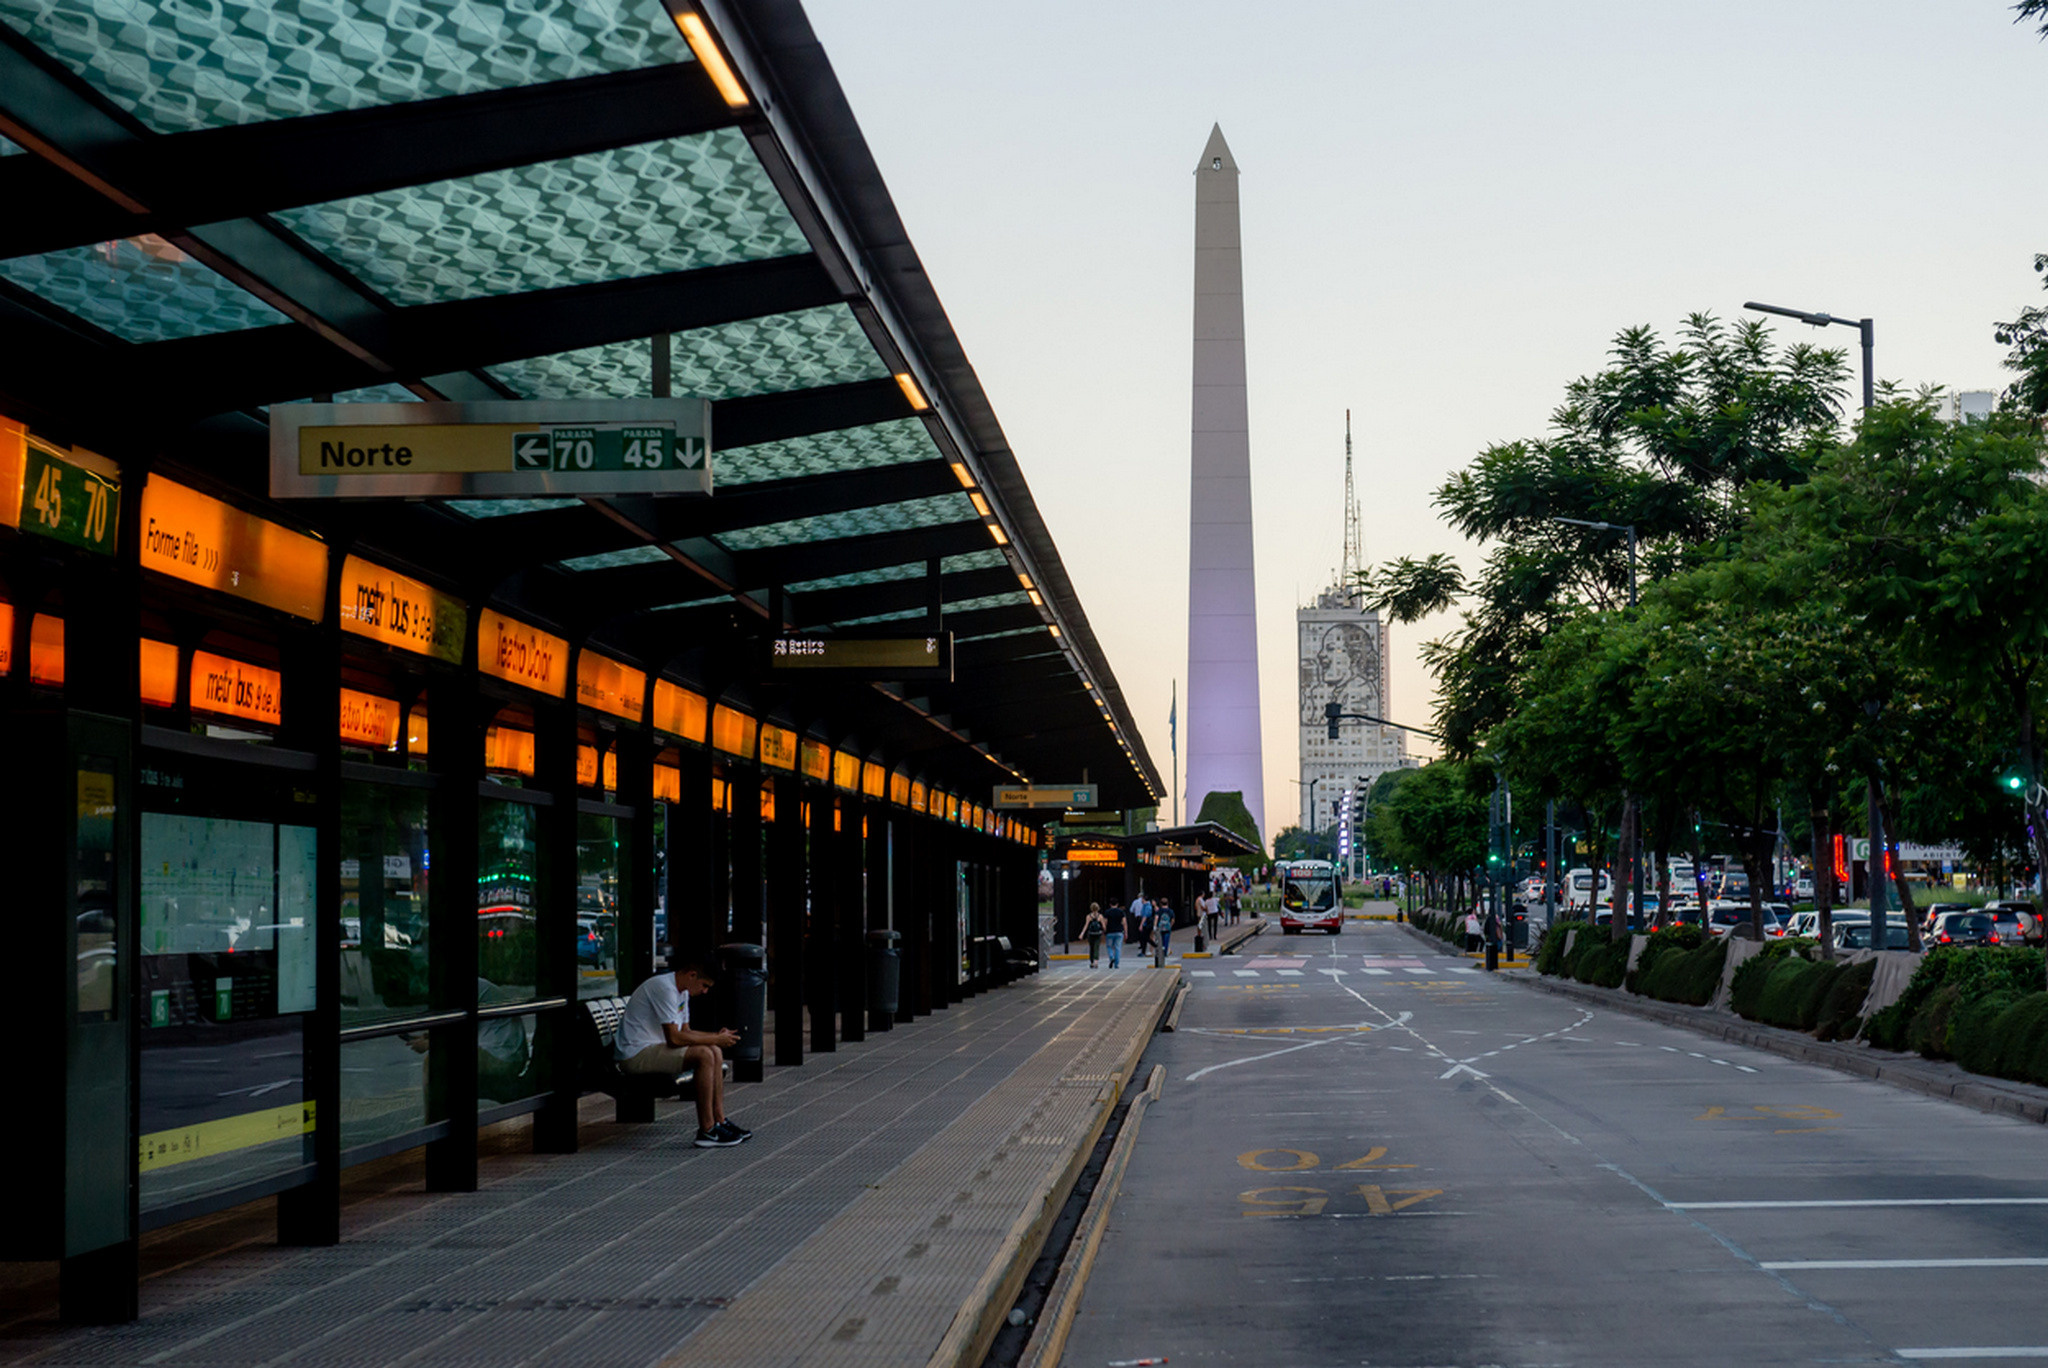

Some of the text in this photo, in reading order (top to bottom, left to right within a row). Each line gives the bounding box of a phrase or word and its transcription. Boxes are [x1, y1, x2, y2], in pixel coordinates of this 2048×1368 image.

[554, 430, 663, 439] PARADA PARADA
[321, 440, 663, 469] Norte 70 45
[34, 464, 107, 543] 45 70
[146, 518, 199, 565] Forme fila
[497, 622, 526, 674] Teatro
[1076, 793, 1088, 802] 10
[1292, 869, 1311, 877] 100
